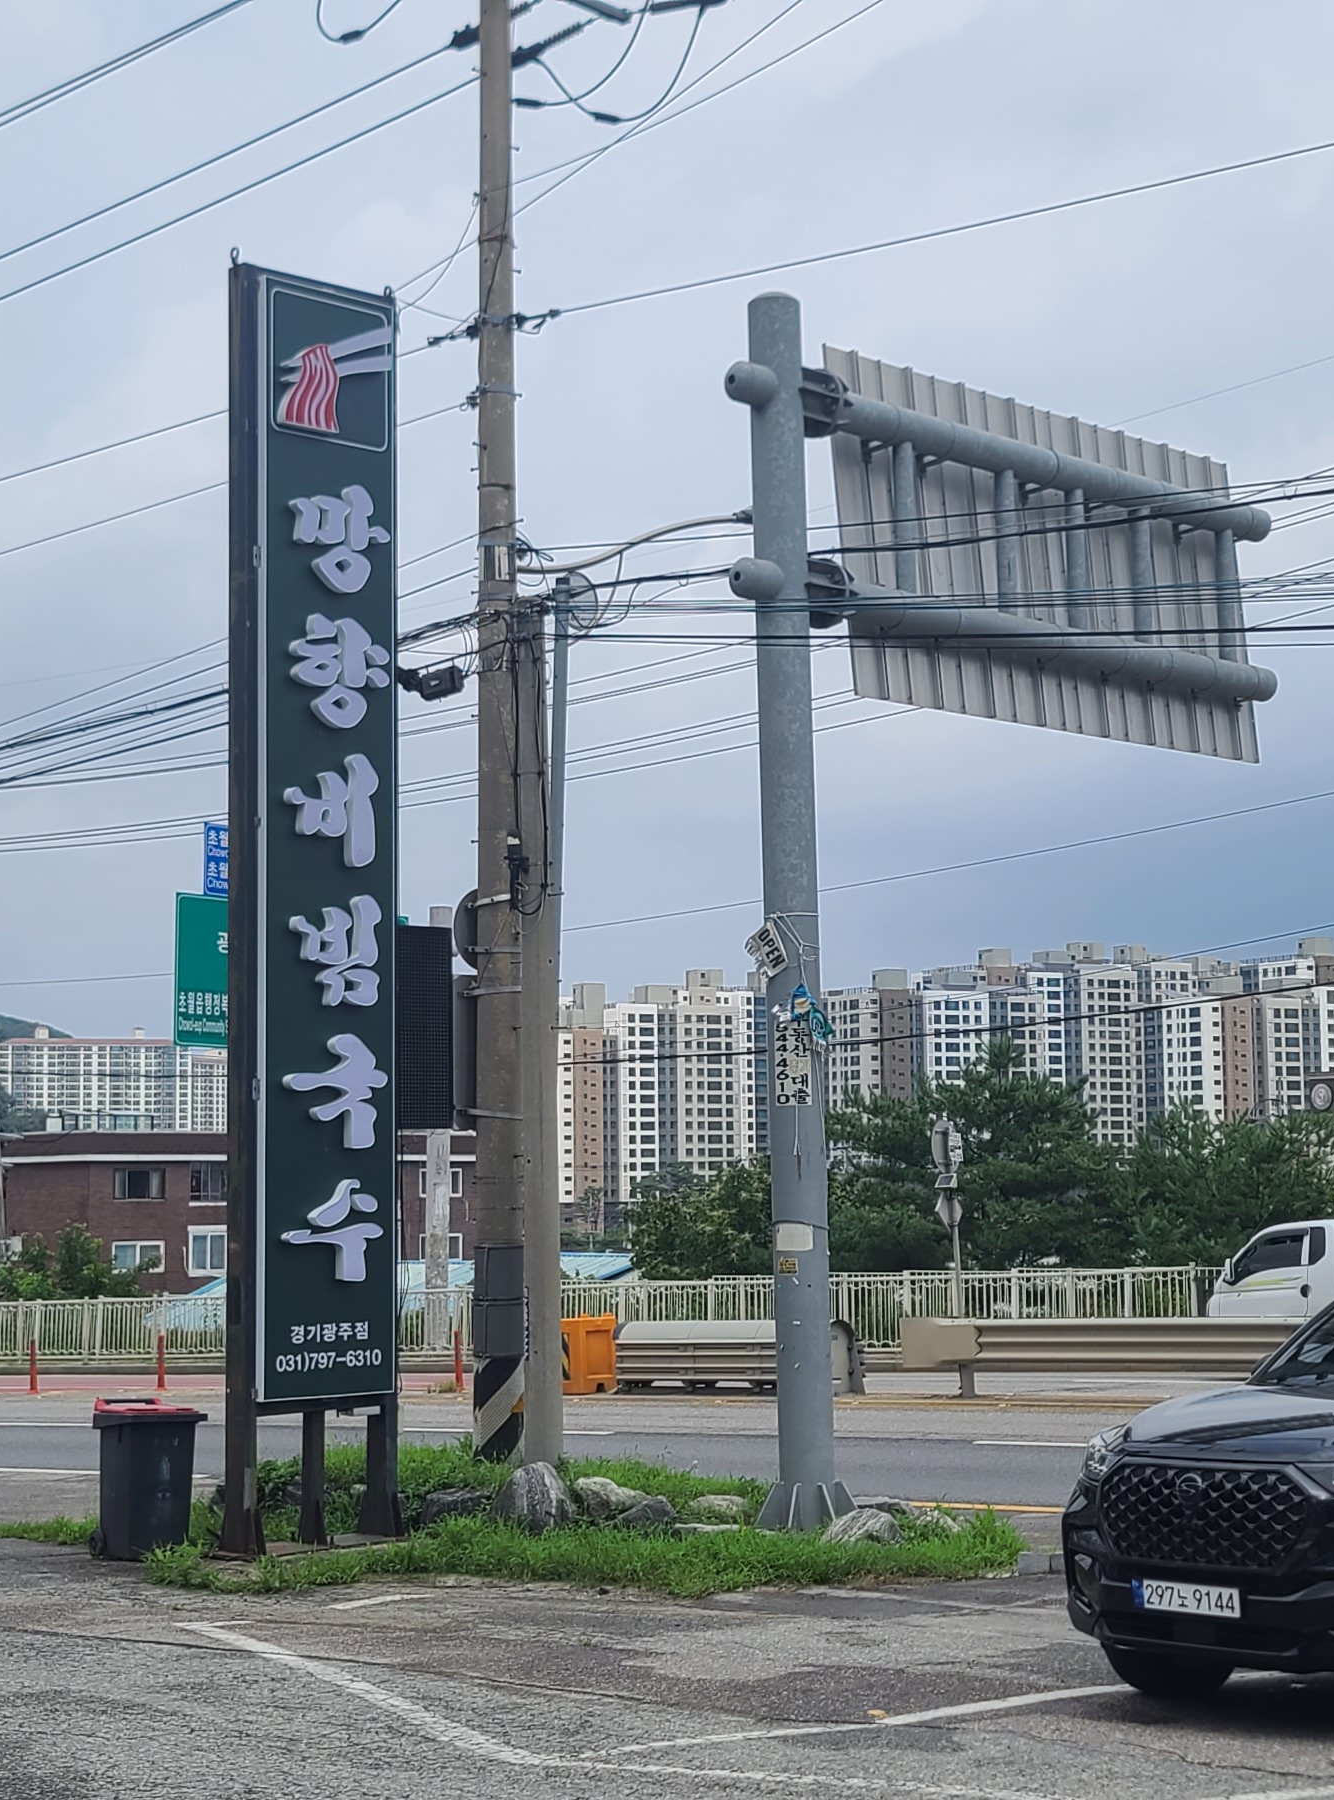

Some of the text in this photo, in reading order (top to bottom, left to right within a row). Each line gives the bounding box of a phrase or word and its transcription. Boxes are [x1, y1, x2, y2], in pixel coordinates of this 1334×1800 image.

[280, 484, 391, 1282] 망향비빔국수
[758, 928, 786, 969] OPEN
[290, 1321, 369, 1345] 경기광주점
[276, 1348, 382, 1372] 031)797-6310
[1145, 1583, 1236, 1614] 297노 9144
